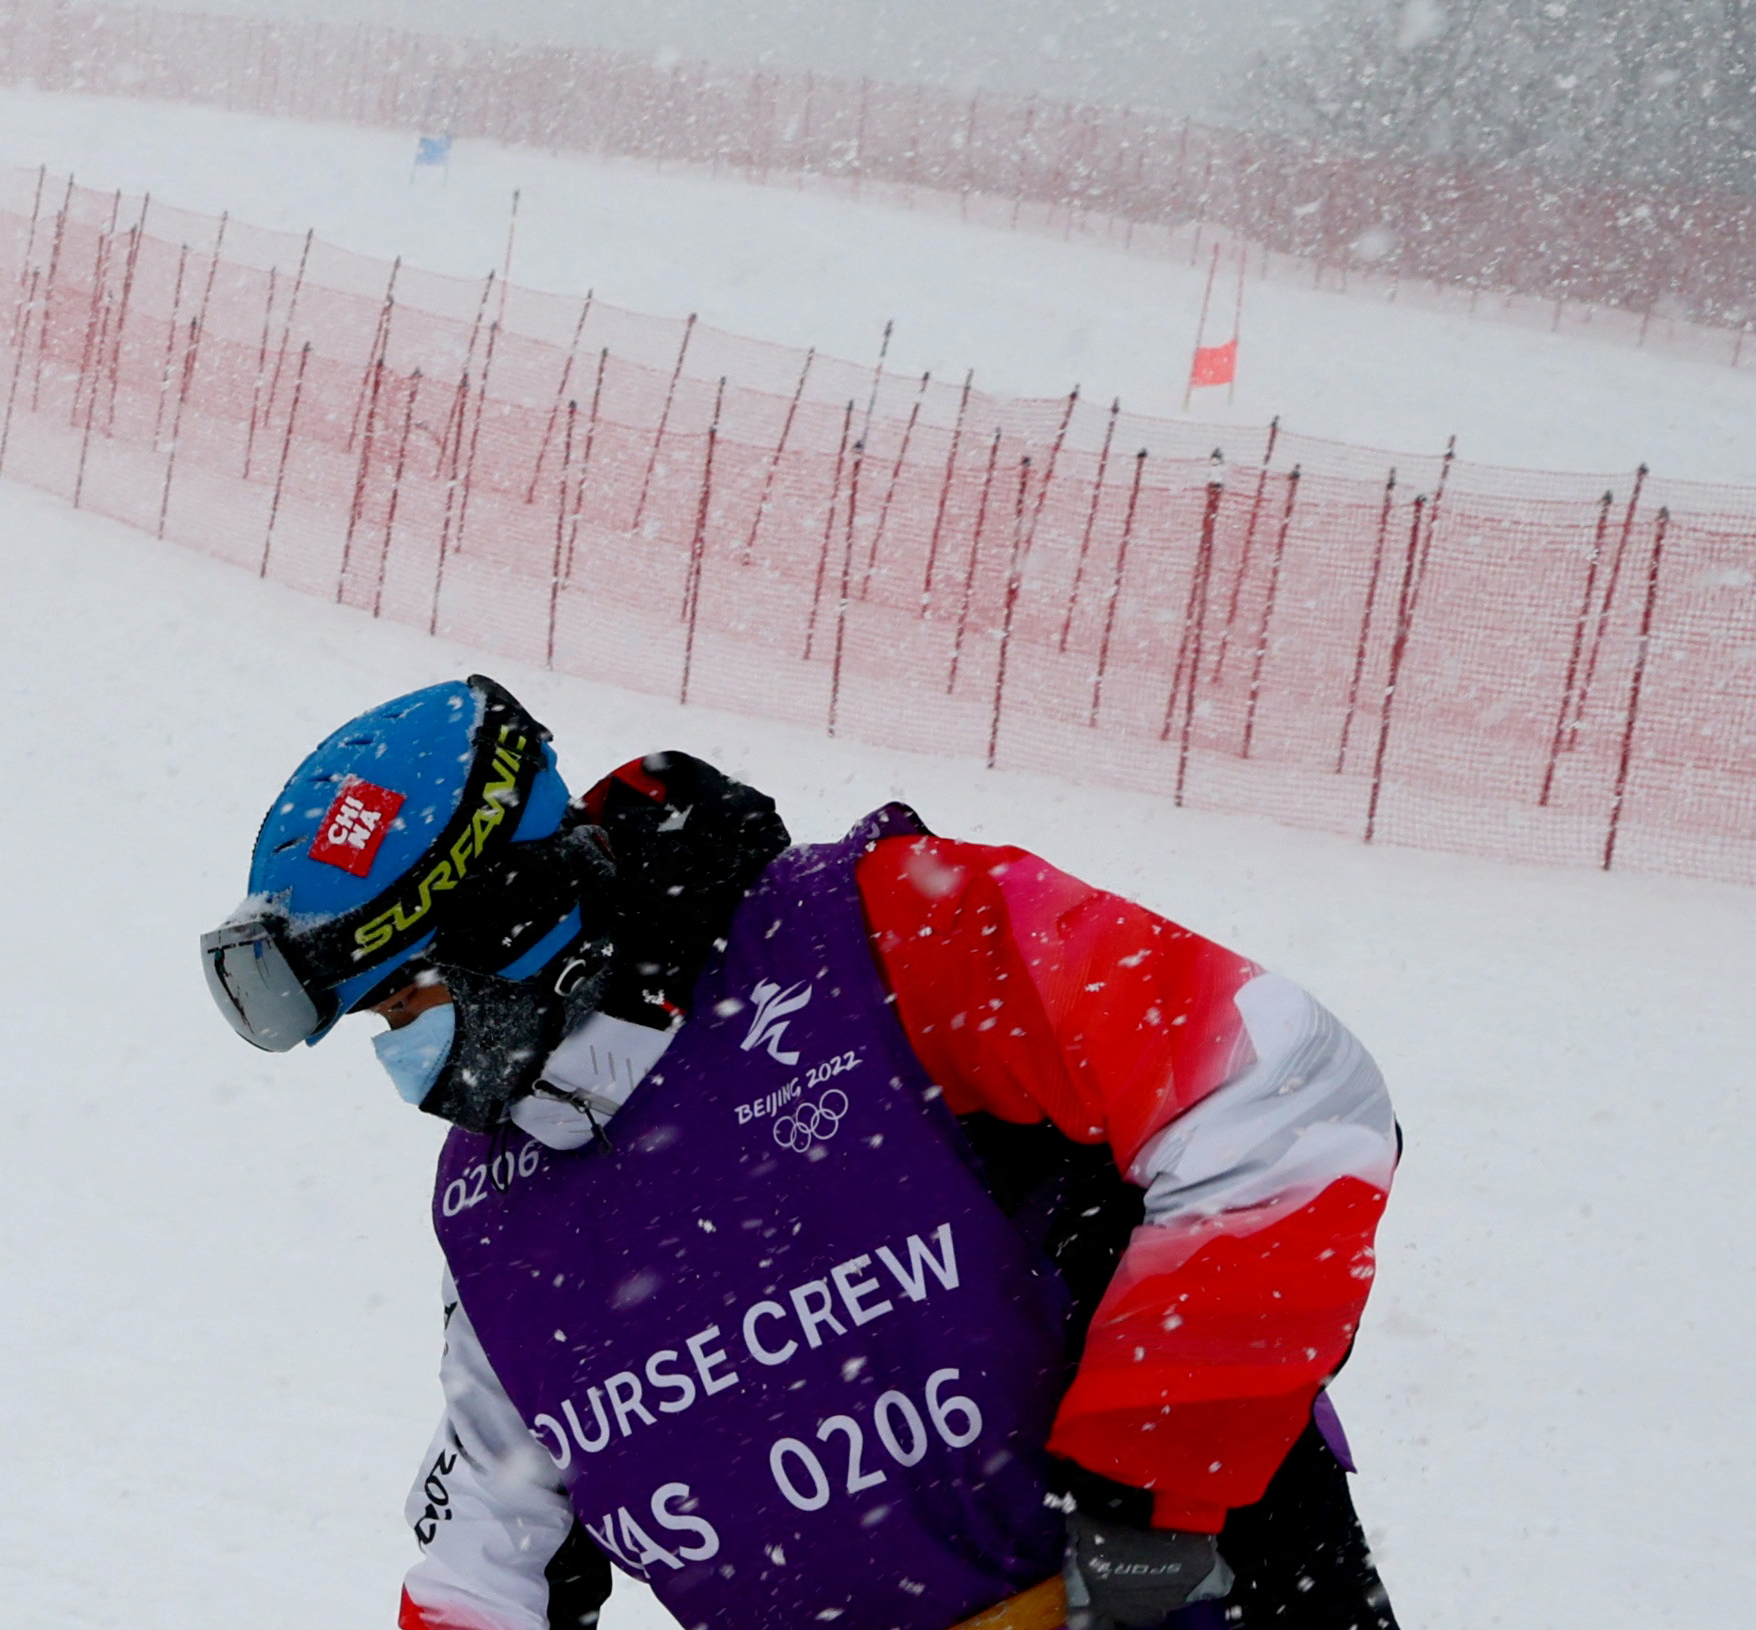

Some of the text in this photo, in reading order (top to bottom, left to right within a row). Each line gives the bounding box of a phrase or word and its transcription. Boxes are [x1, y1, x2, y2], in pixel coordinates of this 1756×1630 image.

[328, 795, 365, 846] CHI
[346, 807, 382, 850] NA
[733, 1050, 864, 1125] BEIJING 2022
[442, 1138, 540, 1217] 0206
[528, 1325, 739, 1469] OURSE
[742, 1222, 960, 1366] CREW
[769, 1368, 983, 1512] 0206
